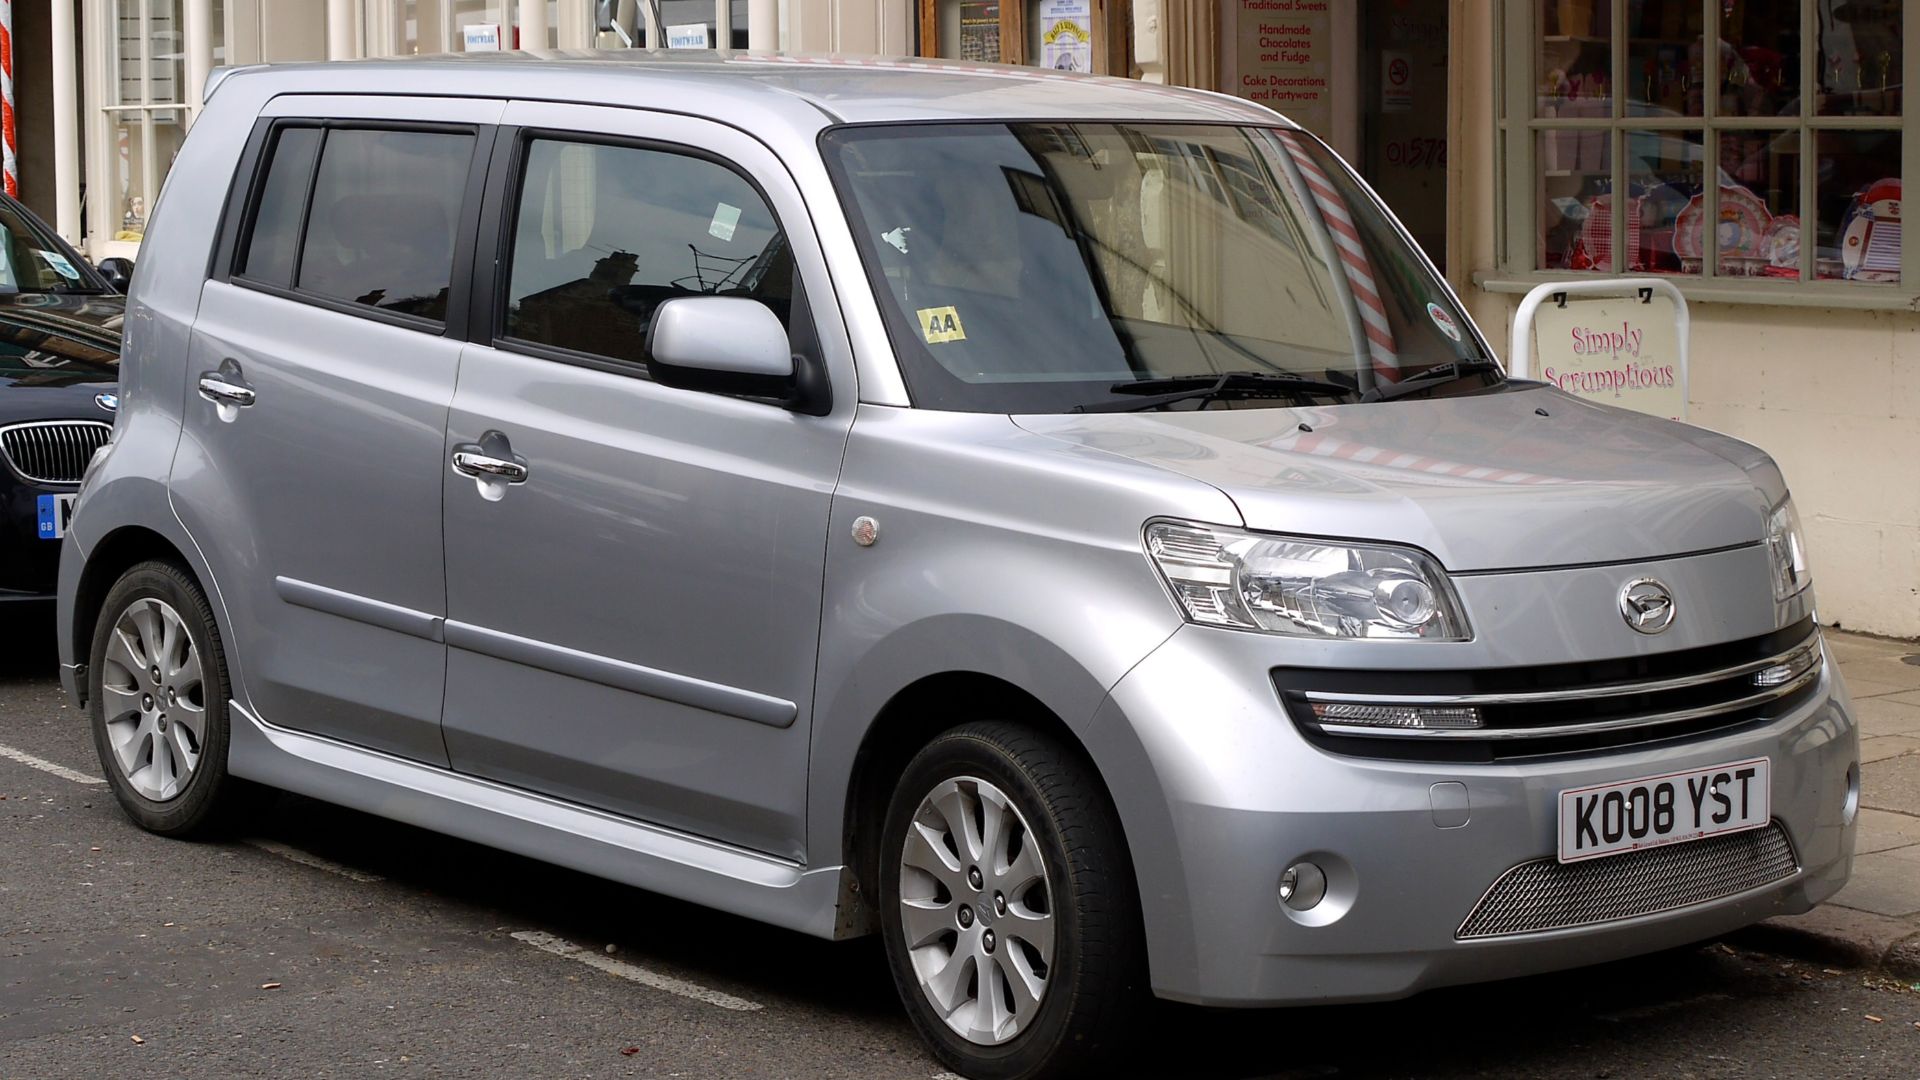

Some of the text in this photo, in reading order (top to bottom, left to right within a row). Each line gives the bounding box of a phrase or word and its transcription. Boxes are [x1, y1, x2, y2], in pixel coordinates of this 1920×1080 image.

[1243, 0, 1327, 11] Traditional Sweets
[1259, 24, 1311, 35] Handmade
[467, 35, 495, 44] FOOTWEAR
[671, 35, 704, 48] FOOTWEAR
[1259, 37, 1311, 49] Chocolates
[1260, 51, 1311, 64] and Fudge
[1243, 75, 1326, 87] Cake Decorations
[1250, 89, 1318, 101] and Partyware
[929, 313, 957, 335] AA
[1571, 321, 1642, 360] Simply
[1545, 362, 1674, 398] Scrumptious
[41, 522, 53, 531] GB
[1575, 768, 1755, 850] KO08 YST
